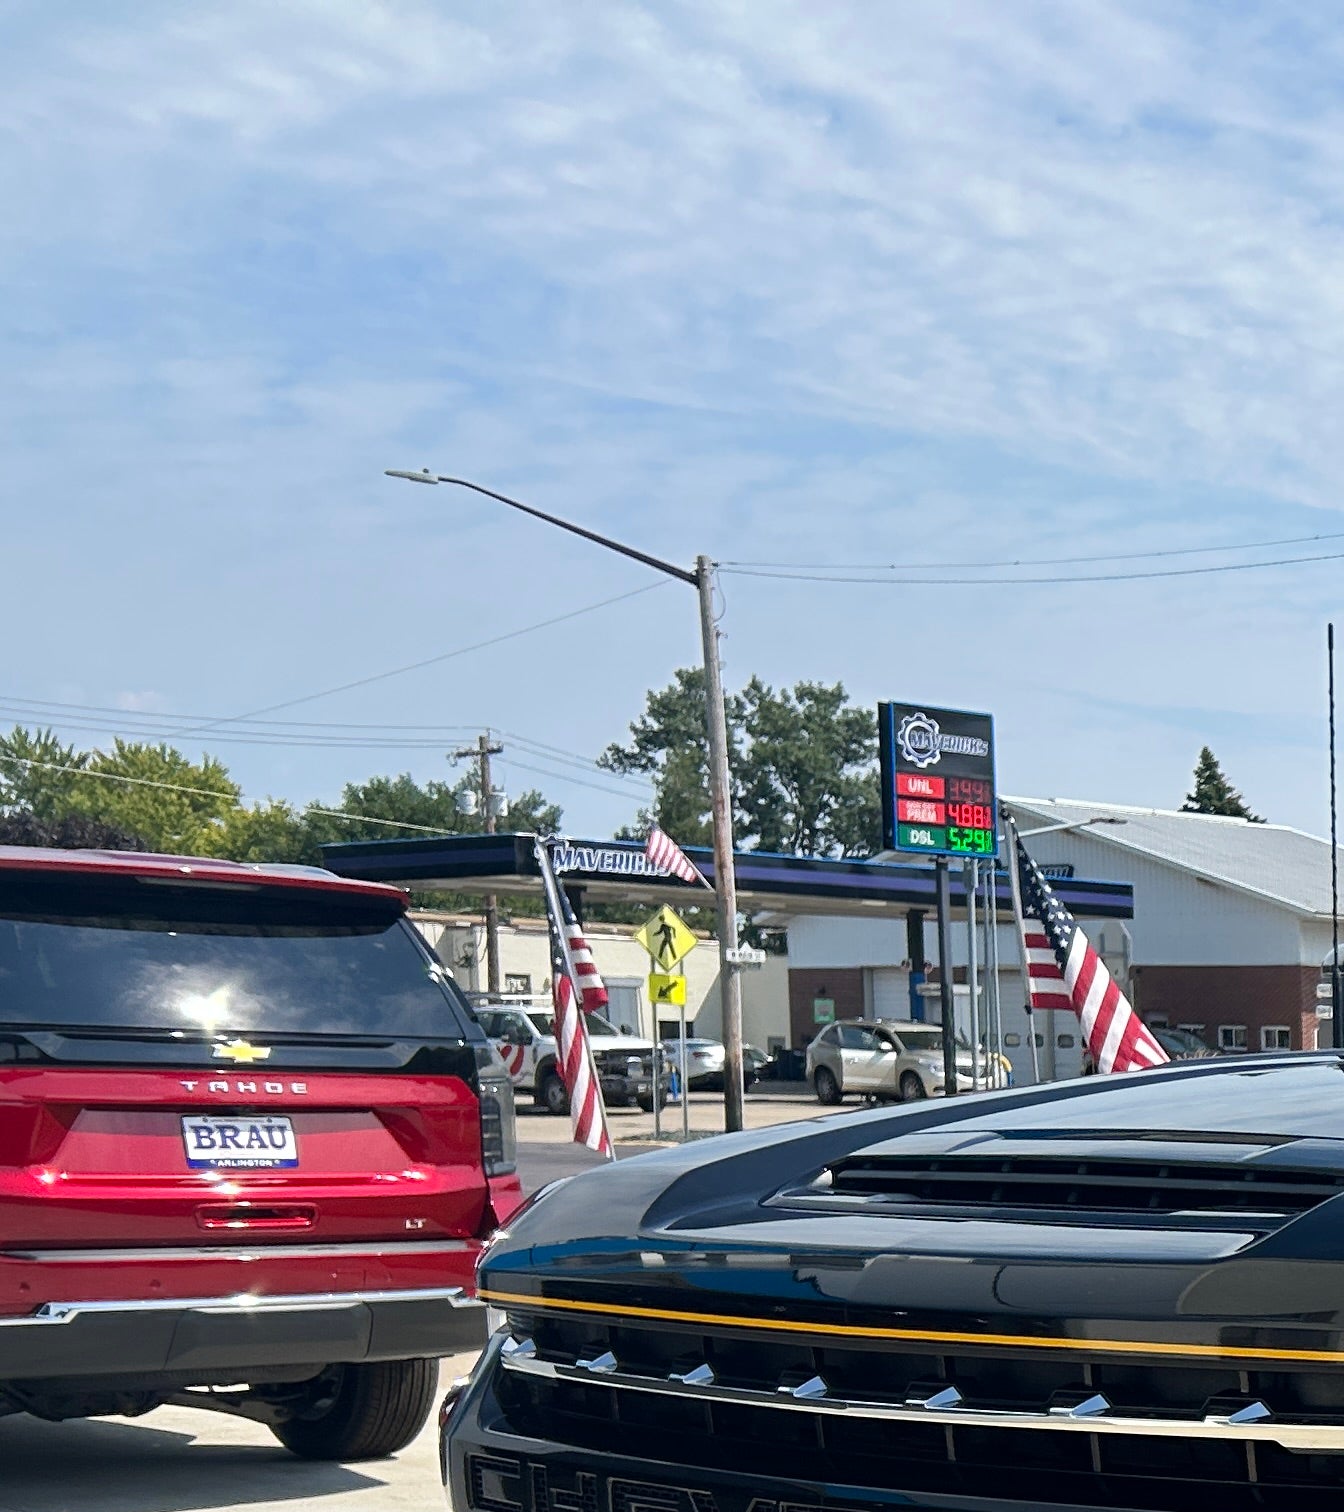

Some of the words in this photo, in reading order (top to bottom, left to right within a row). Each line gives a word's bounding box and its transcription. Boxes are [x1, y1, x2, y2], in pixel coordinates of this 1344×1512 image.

[908, 778, 934, 795] UNL
[910, 829, 935, 846] DSL
[180, 1081, 307, 1094] TAHOE
[189, 1124, 288, 1150] BRAU
[405, 1218, 426, 1229] LT
